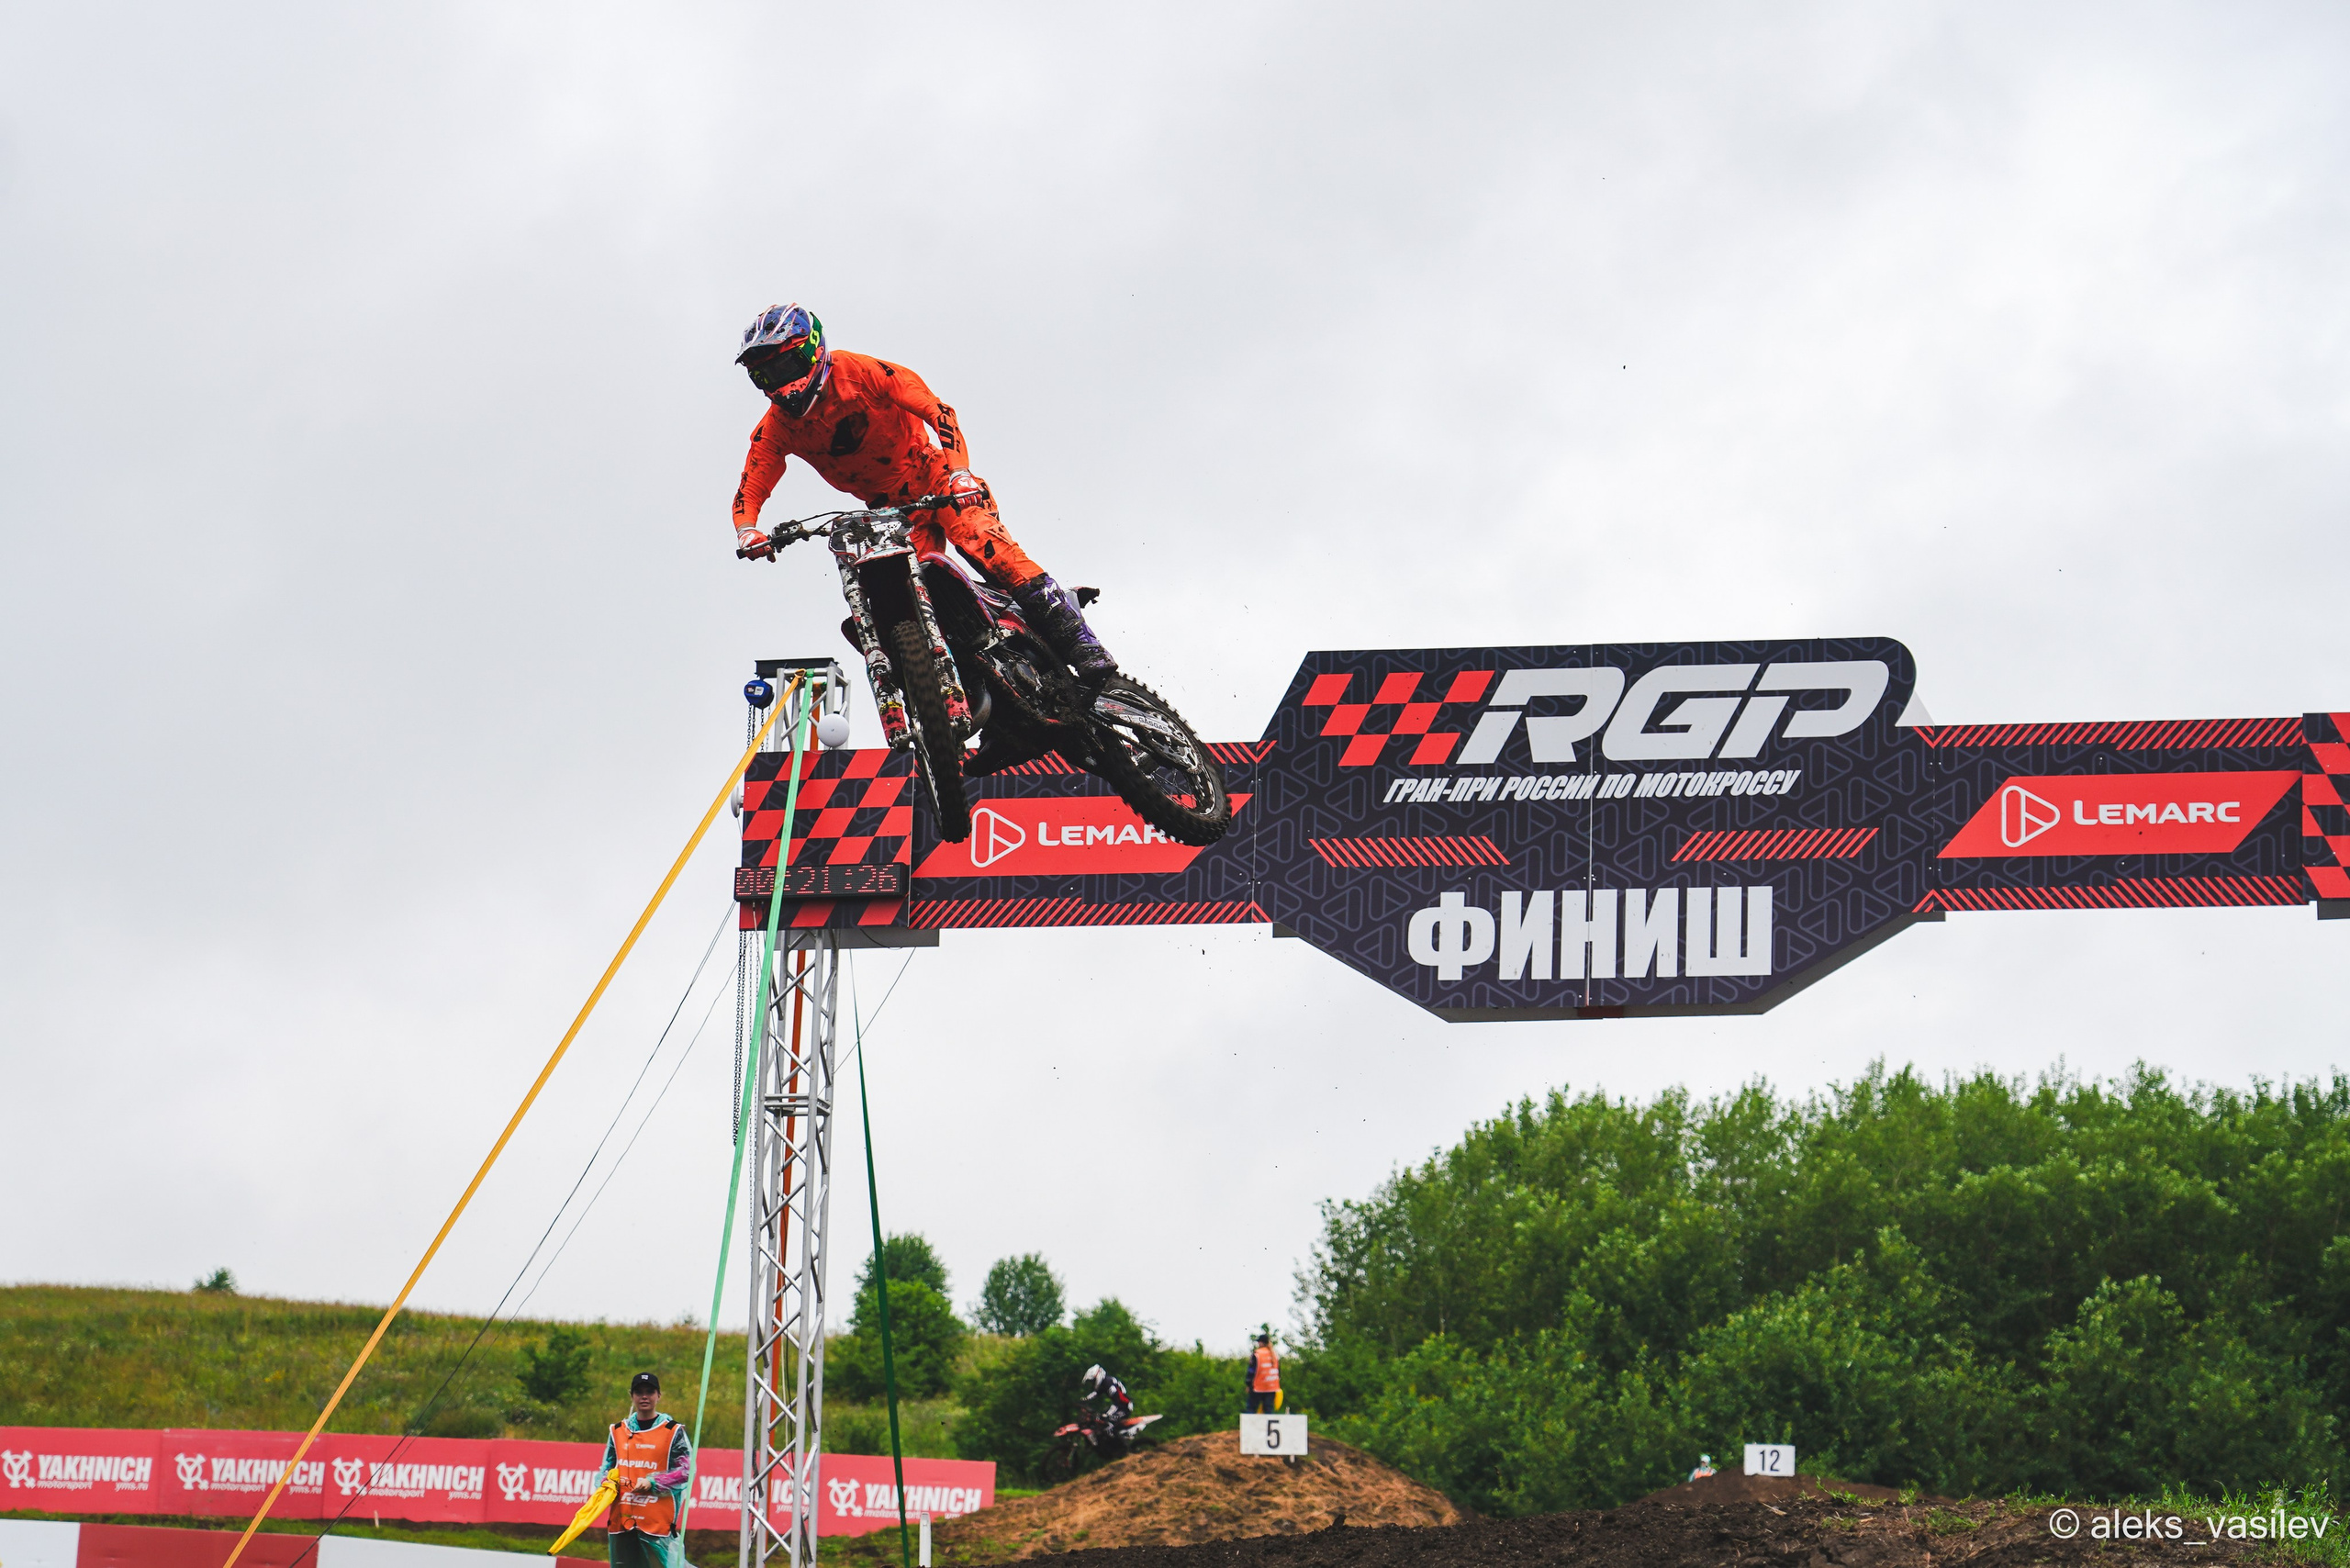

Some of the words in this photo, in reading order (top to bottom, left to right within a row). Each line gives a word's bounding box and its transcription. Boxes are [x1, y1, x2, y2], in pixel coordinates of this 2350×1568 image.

[1456, 660, 1890, 765] RGP
[1383, 776, 1503, 803] ГРАН-ПРИ
[1497, 774, 1601, 801] РОССИИ
[1595, 773, 1637, 799] ПО
[1633, 769, 1802, 798] МОТОКРОССУ
[2073, 799, 2241, 826] LEMARC
[1037, 821, 1184, 846] LEMAR
[1407, 885, 1774, 980] ФИНИШ
[1267, 1419, 1281, 1450] 5
[38, 1454, 152, 1483] YAKHNICH
[1759, 1450, 1780, 1472] 12
[37, 1480, 93, 1492] motorsport
[210, 1482, 266, 1494] motorsport
[369, 1462, 486, 1492] YAKHNICH
[532, 1467, 600, 1495] YAKH
[368, 1487, 425, 1499] motorsport
[621, 1492, 659, 1505] RGP
